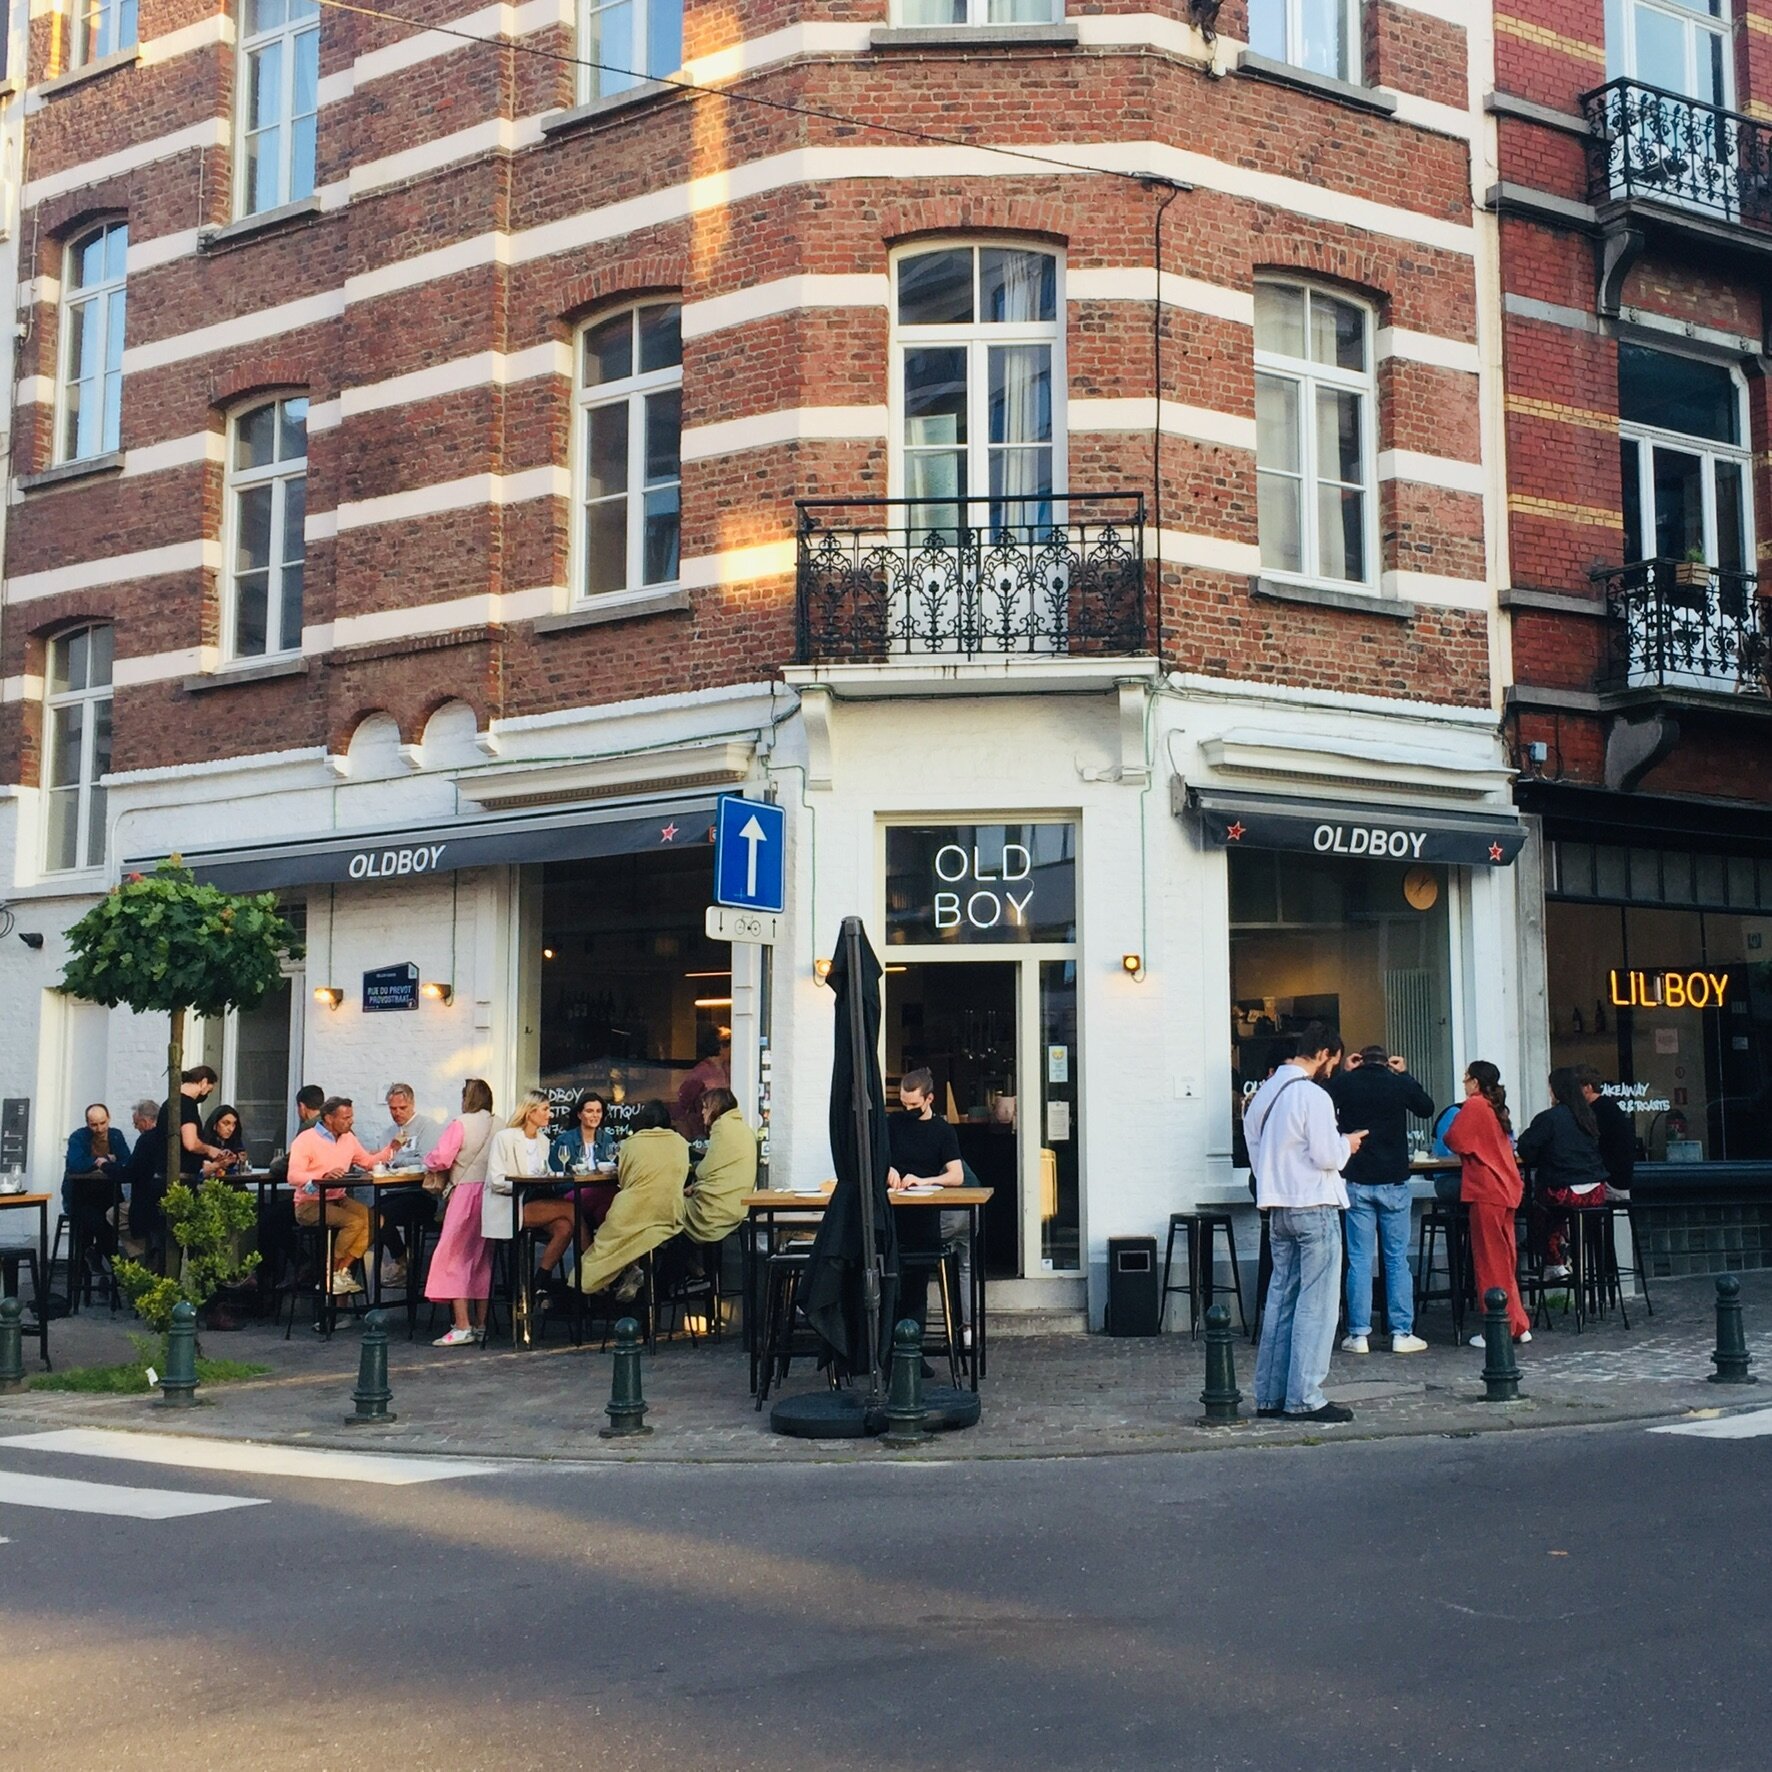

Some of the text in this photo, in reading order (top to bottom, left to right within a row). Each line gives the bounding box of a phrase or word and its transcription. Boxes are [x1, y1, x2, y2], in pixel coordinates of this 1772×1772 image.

[1313, 824, 1428, 859] OLDBOY
[348, 844, 447, 879] OLDBOY
[934, 844, 1031, 882] OLD
[934, 890, 1034, 928] BOY
[367, 986, 379, 996] RUE
[1600, 1082, 1650, 1098] AKEAWAY
